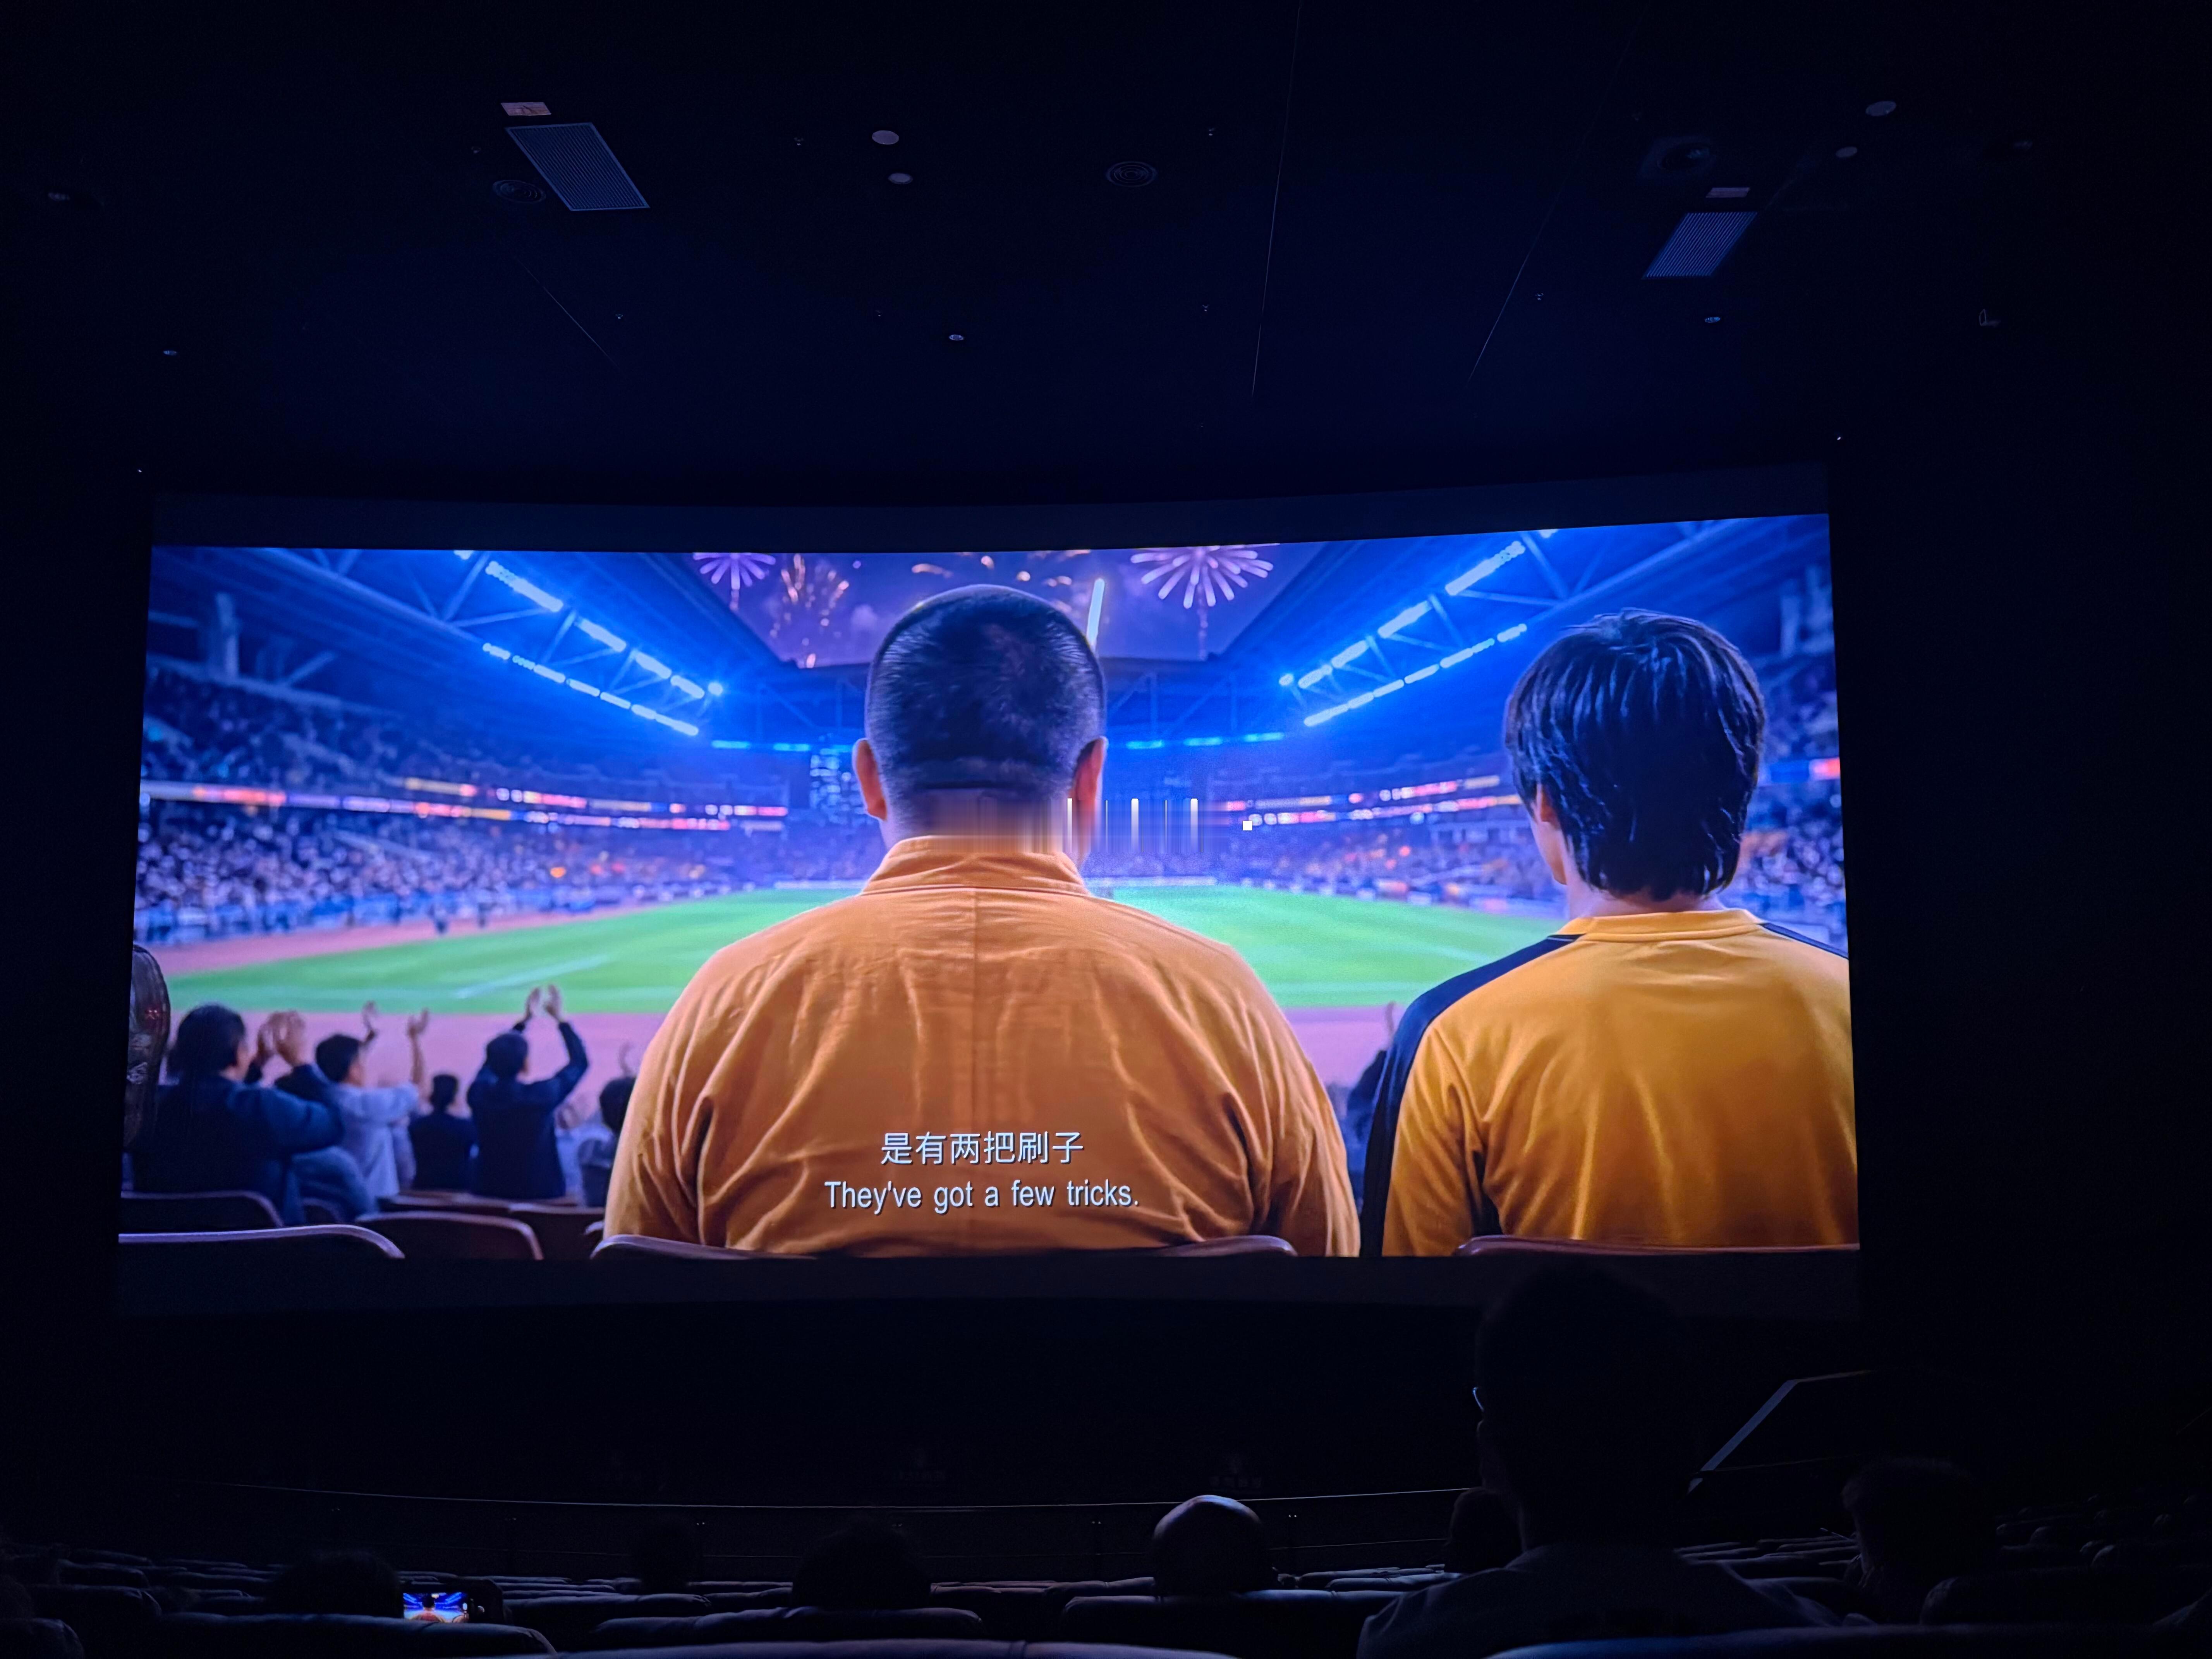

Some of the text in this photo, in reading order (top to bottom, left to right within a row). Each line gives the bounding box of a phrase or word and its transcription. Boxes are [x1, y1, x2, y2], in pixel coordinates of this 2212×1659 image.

[880, 1130, 1084, 1165] 是有两把刷子
[824, 1178, 1139, 1215] They've got a few tricks.
